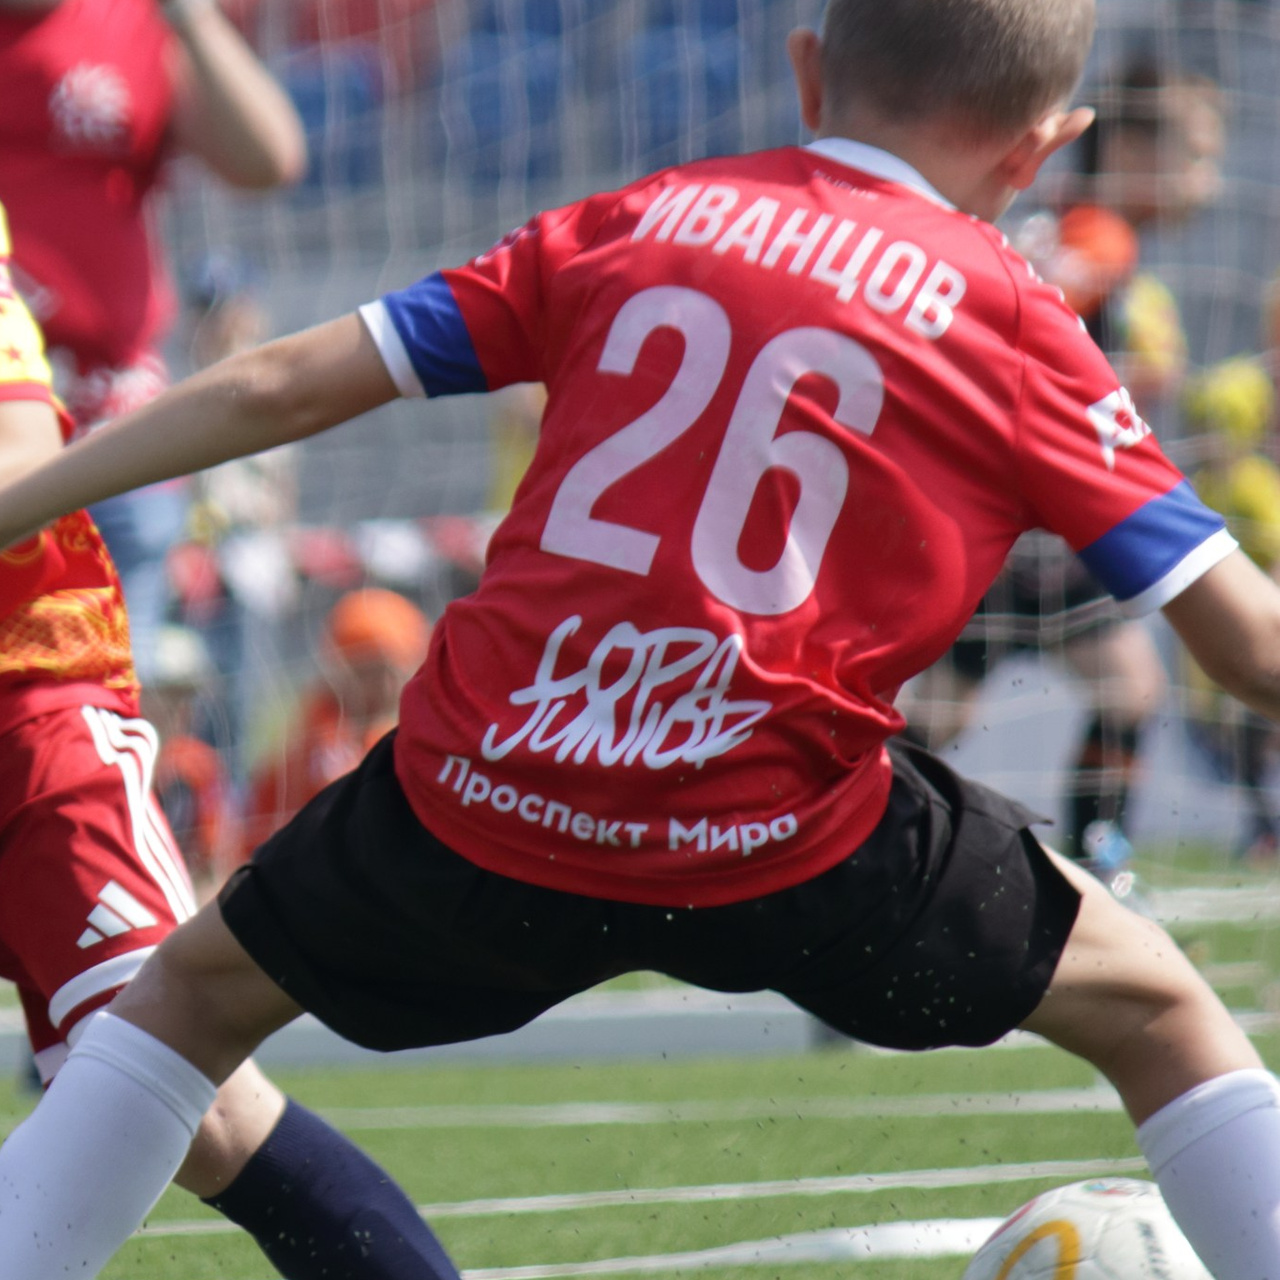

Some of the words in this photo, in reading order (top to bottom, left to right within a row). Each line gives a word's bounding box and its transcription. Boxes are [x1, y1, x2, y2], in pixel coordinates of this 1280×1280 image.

[630, 183, 967, 340] ИВАНЦОВ
[540, 285, 886, 616] 26
[437, 754, 649, 848] Проспект
[668, 812, 799, 856] Мира
